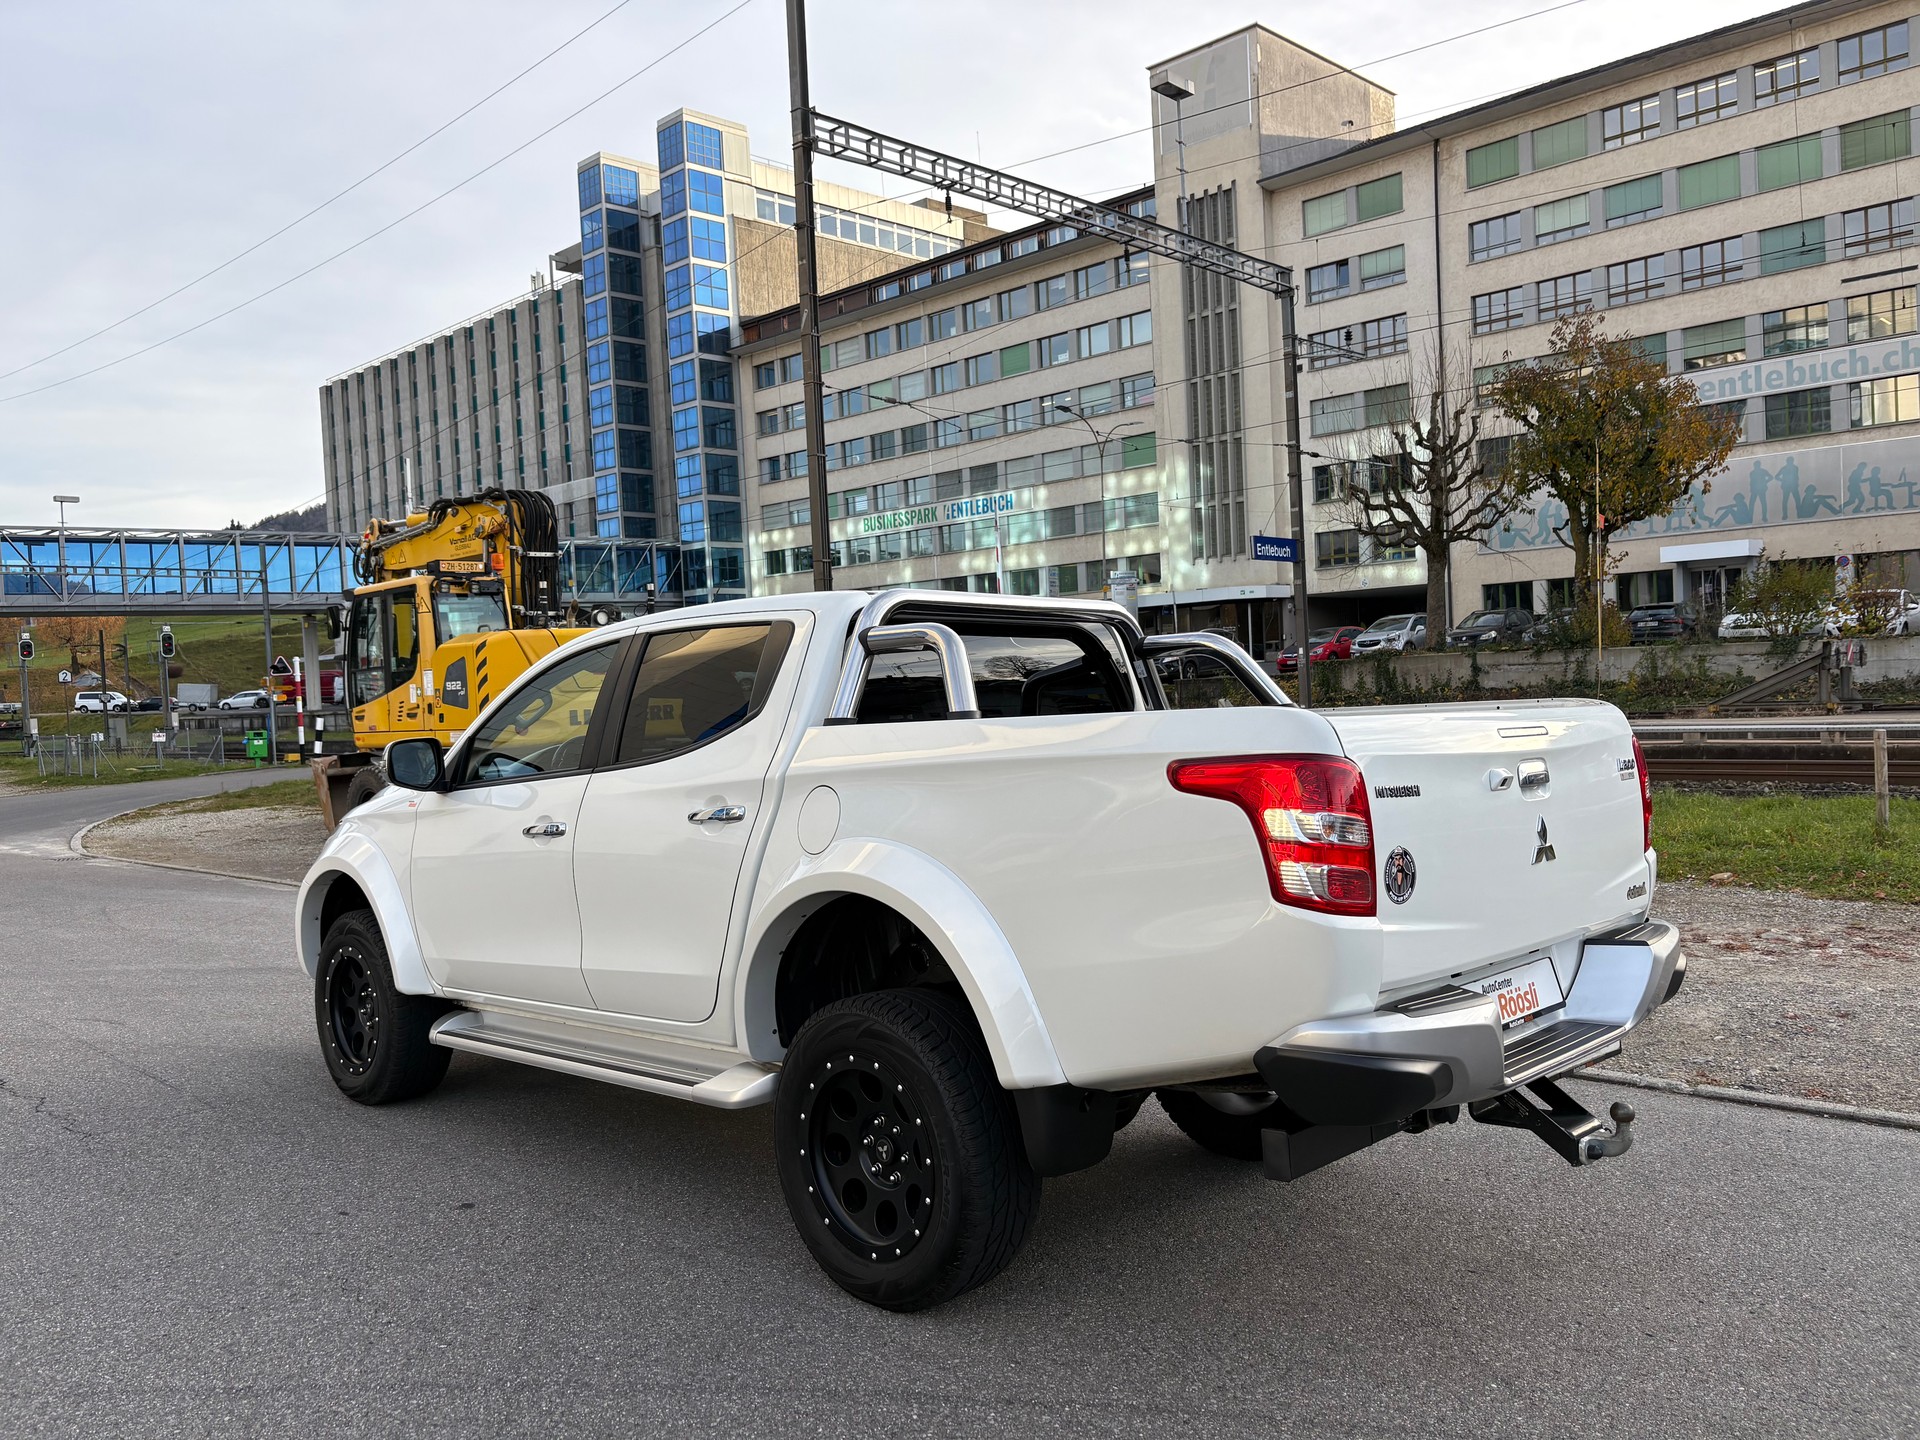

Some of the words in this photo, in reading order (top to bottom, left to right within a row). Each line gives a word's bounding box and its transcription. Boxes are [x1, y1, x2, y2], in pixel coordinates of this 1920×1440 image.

[1699, 341, 1920, 400] entlebuch.ch
[863, 506, 938, 533] BUSINESSPARK
[951, 493, 1013, 520] ENTLEBUCH
[1256, 543, 1291, 558] Entlebuch
[61, 672, 68, 681] 2
[445, 681, 462, 691] 922
[1374, 784, 1421, 798] MITSUBISHI
[1481, 977, 1513, 995] AutoCenter
[1497, 981, 1540, 1020] Röösli
